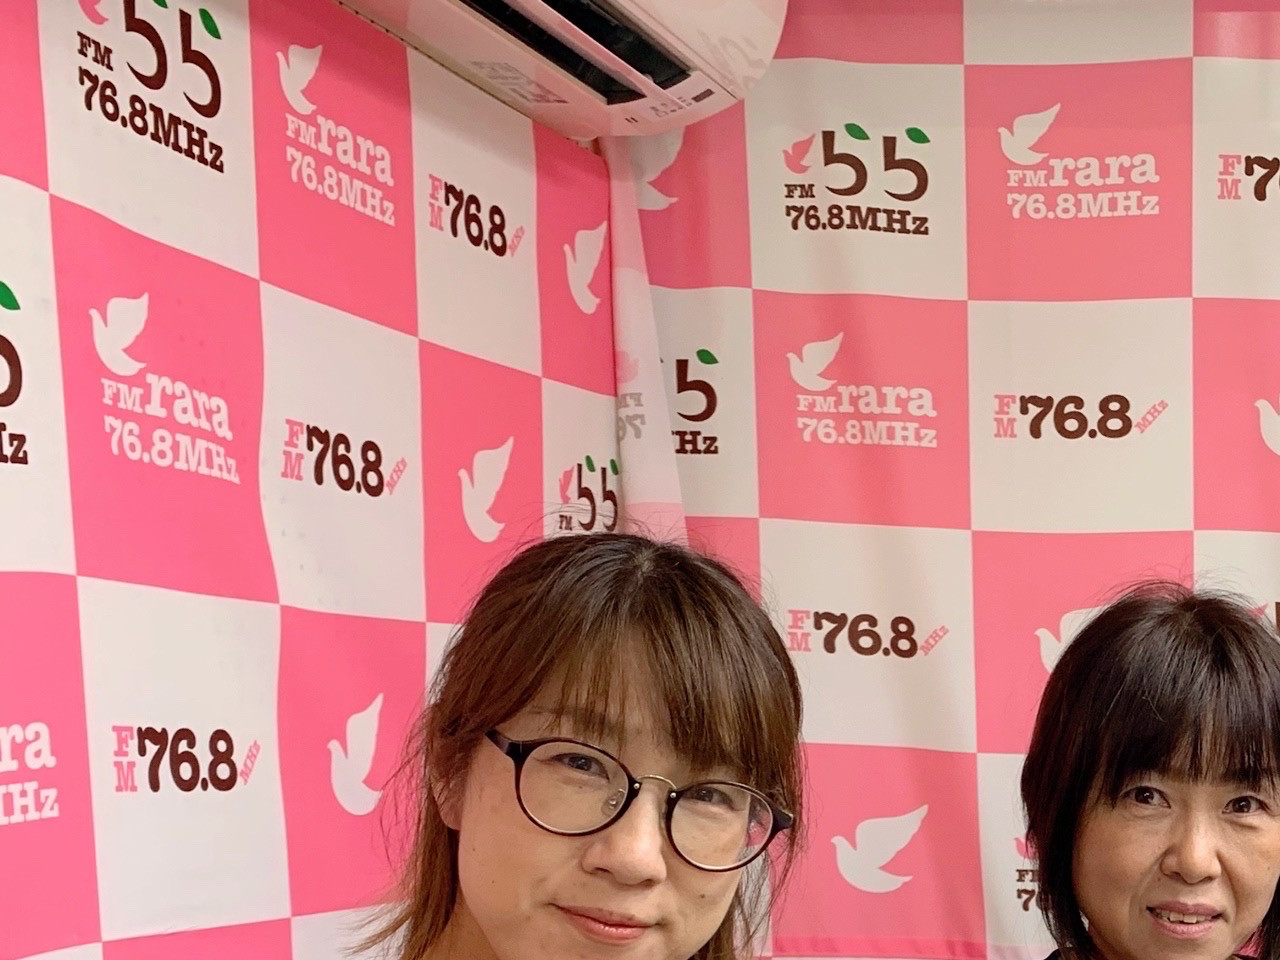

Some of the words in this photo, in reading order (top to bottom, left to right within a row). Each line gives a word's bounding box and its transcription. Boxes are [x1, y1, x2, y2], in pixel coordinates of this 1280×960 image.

[76, 31, 113, 71] FM
[78, 68, 224, 173] 76.8MHz
[285, 113, 316, 150] FM
[316, 115, 395, 186] rara
[1006, 169, 1048, 188] FM
[1048, 151, 1160, 188] rara
[285, 149, 395, 226] 76.8MHz
[784, 183, 815, 199] FM
[1006, 190, 1160, 220] 76.8MHz
[444, 183, 508, 257] 76.8
[508, 226, 525, 257] MHz
[784, 205, 930, 237] 76.8MHz
[101, 378, 144, 414] FM
[145, 372, 233, 441] rara
[796, 394, 837, 414] FM
[837, 382, 937, 418] rara
[1018, 393, 1132, 440] 76.8
[1133, 398, 1169, 434] MHz
[104, 415, 240, 485] 76.8MHz
[796, 417, 938, 449] 76.8MHz
[305, 423, 385, 498] 76.8
[385, 457, 408, 496] MHz
[812, 611, 919, 659] 76.8
[919, 624, 949, 656] MHz
[137, 726, 238, 793] 76.8
[239, 740, 261, 786] MHz
